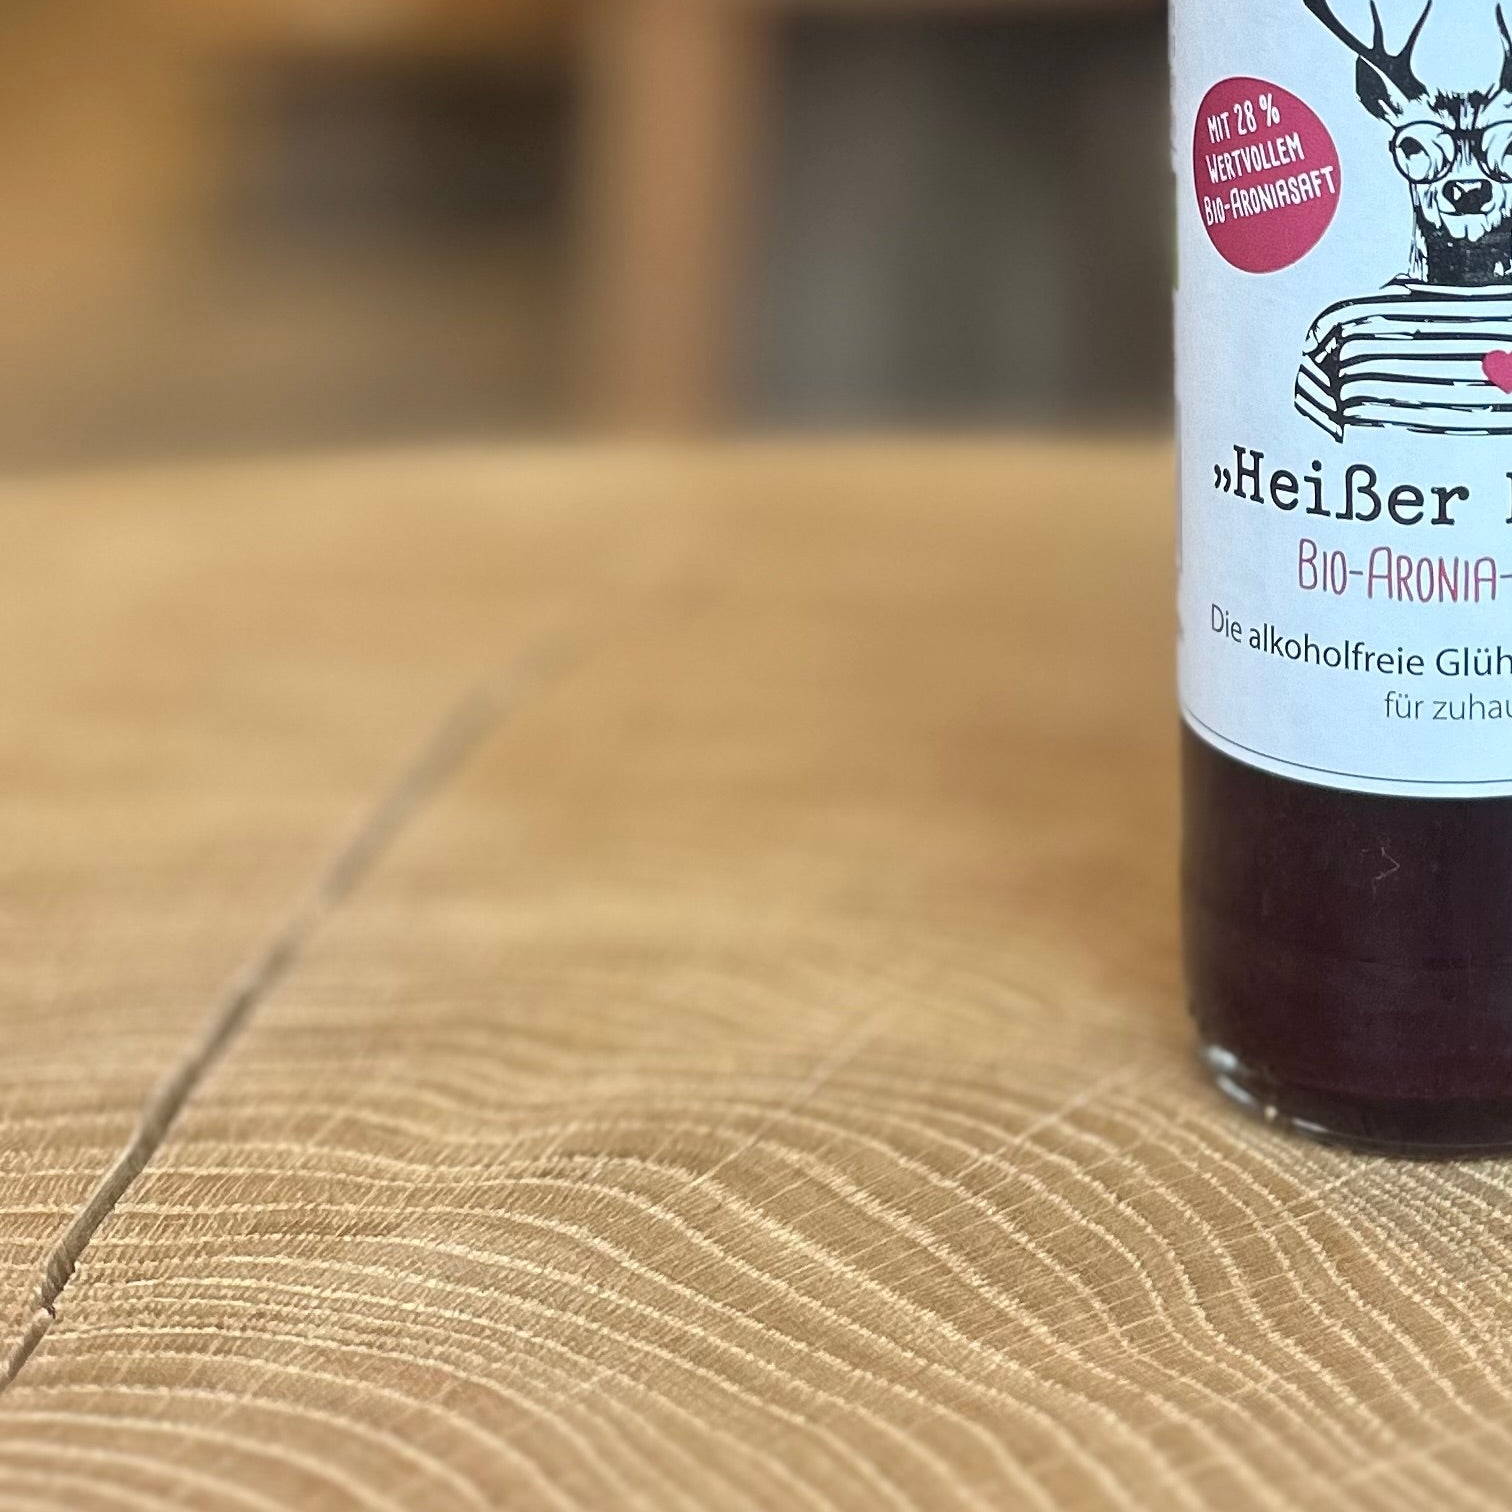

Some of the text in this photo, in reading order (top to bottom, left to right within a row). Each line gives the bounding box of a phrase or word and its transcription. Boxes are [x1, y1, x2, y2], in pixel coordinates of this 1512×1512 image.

[1206, 92, 1281, 144] MIT 28 %
[1205, 131, 1306, 184] WERTVOLLEM
[1203, 165, 1336, 227] BIO-ARONIASAFT
[1213, 444, 1470, 526] „Heißer
[1211, 603, 1243, 643] Die
[1249, 622, 1425, 676] alkoholfreie
[1384, 690, 1424, 720] für
